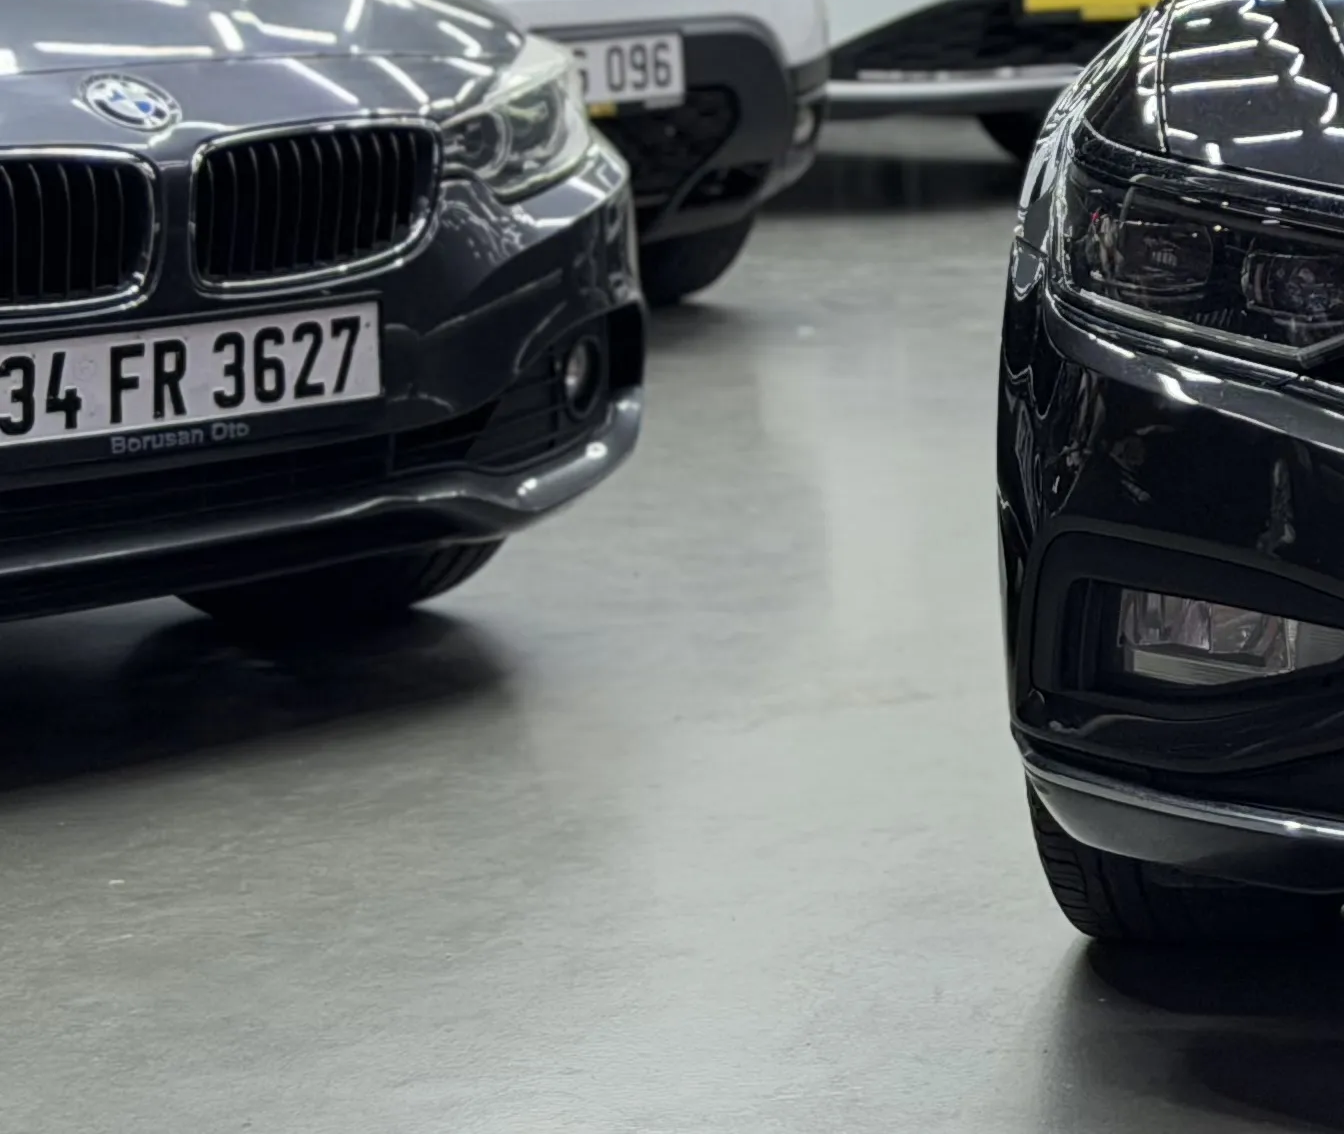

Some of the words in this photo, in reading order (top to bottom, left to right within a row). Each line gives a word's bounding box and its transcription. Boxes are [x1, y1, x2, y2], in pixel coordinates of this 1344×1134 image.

[605, 41, 671, 93] 096
[0, 351, 82, 436] 34
[109, 339, 188, 424] FR
[212, 316, 361, 409] 3627
[110, 429, 204, 455] Borusan
[210, 421, 250, 441] Oto
